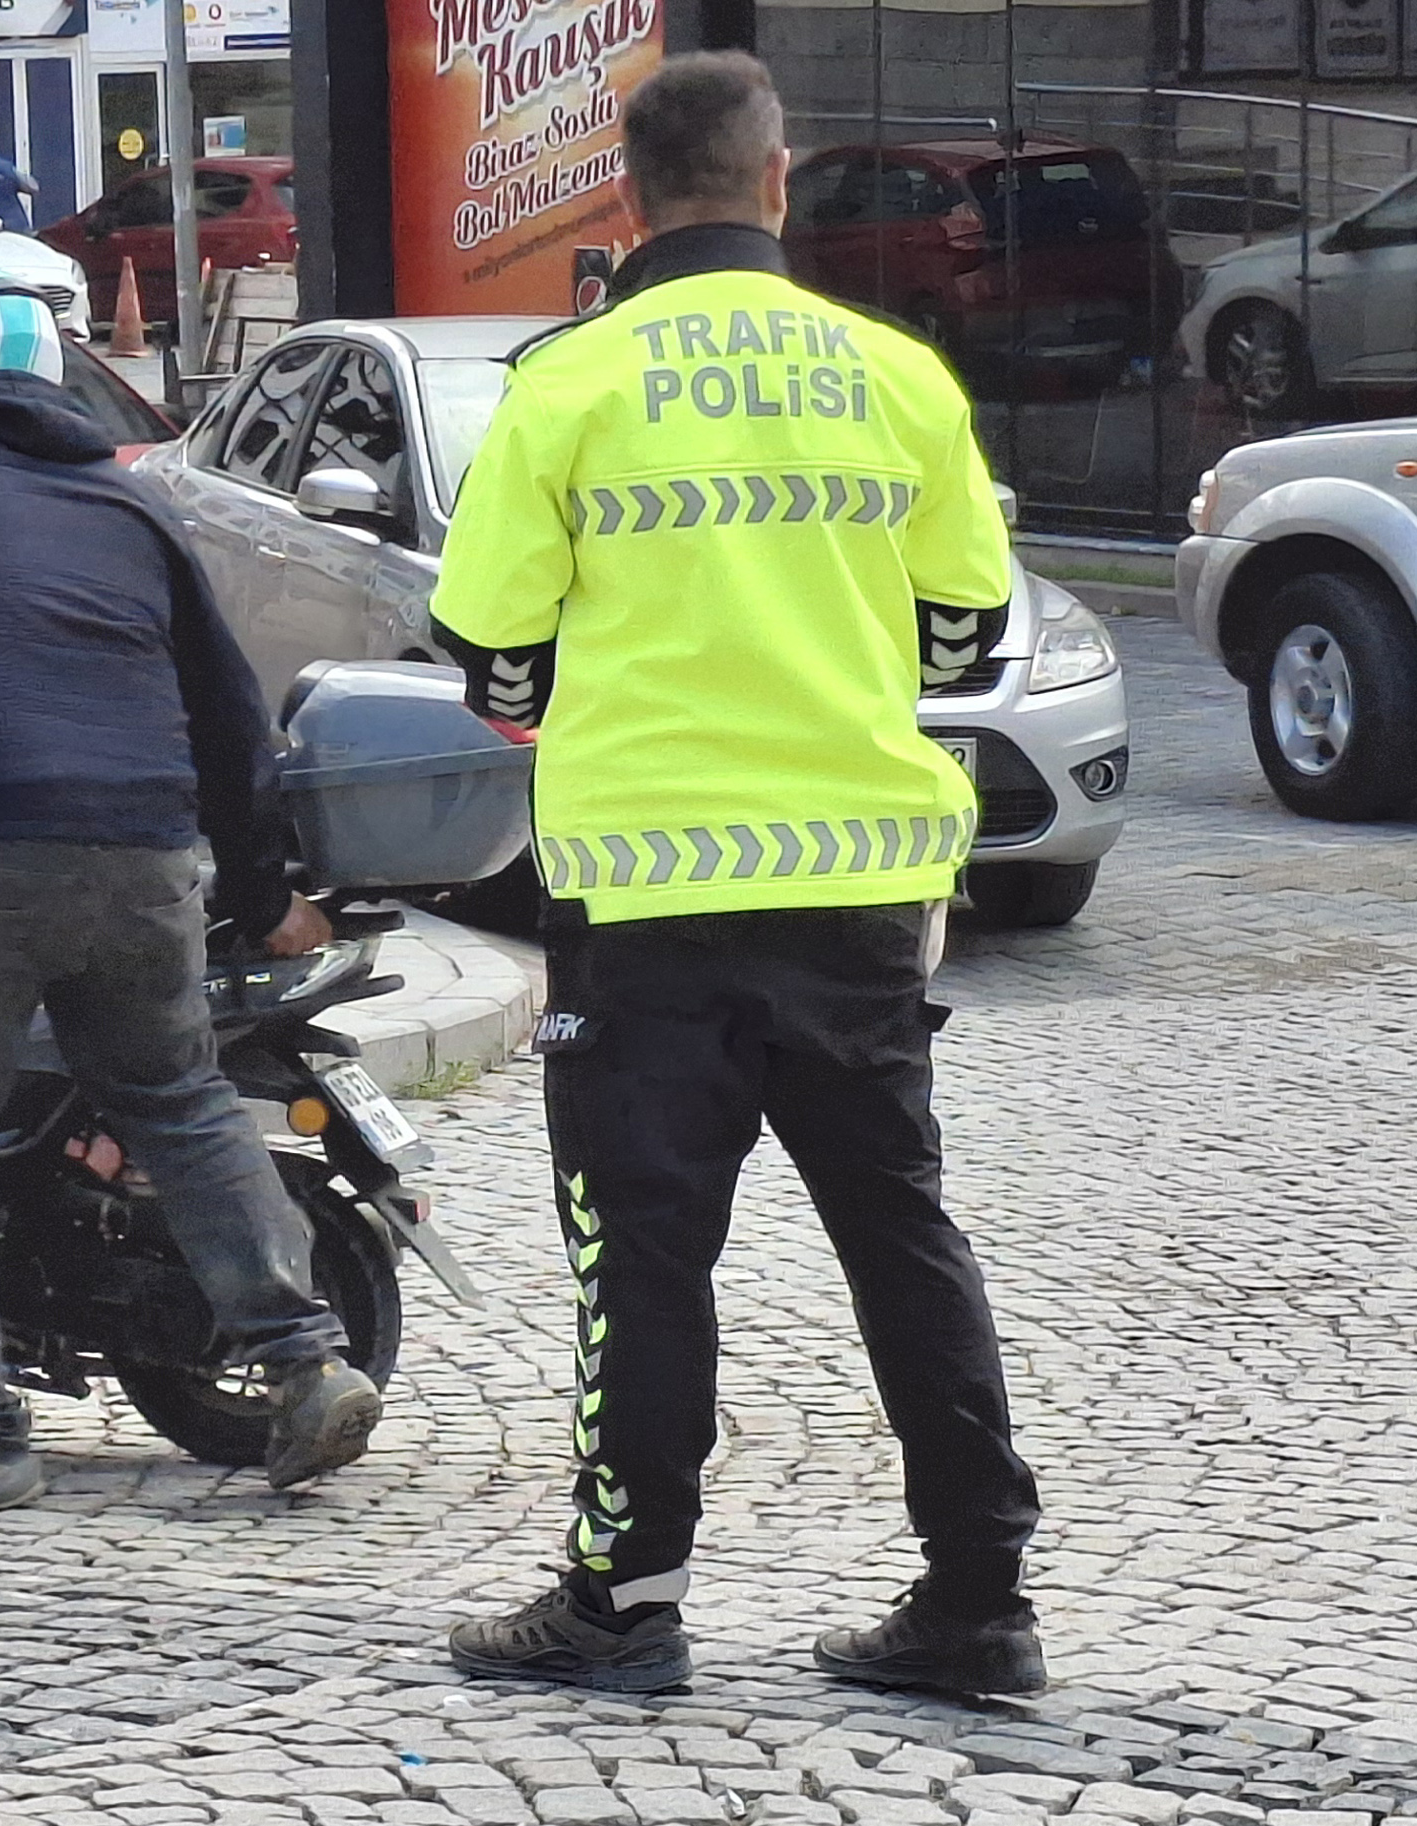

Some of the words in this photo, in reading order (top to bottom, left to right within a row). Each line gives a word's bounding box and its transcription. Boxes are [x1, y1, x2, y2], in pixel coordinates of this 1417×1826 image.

[467, 138, 539, 187] Biraz
[545, 88, 615, 147] Soslu
[456, 190, 503, 246] Bol
